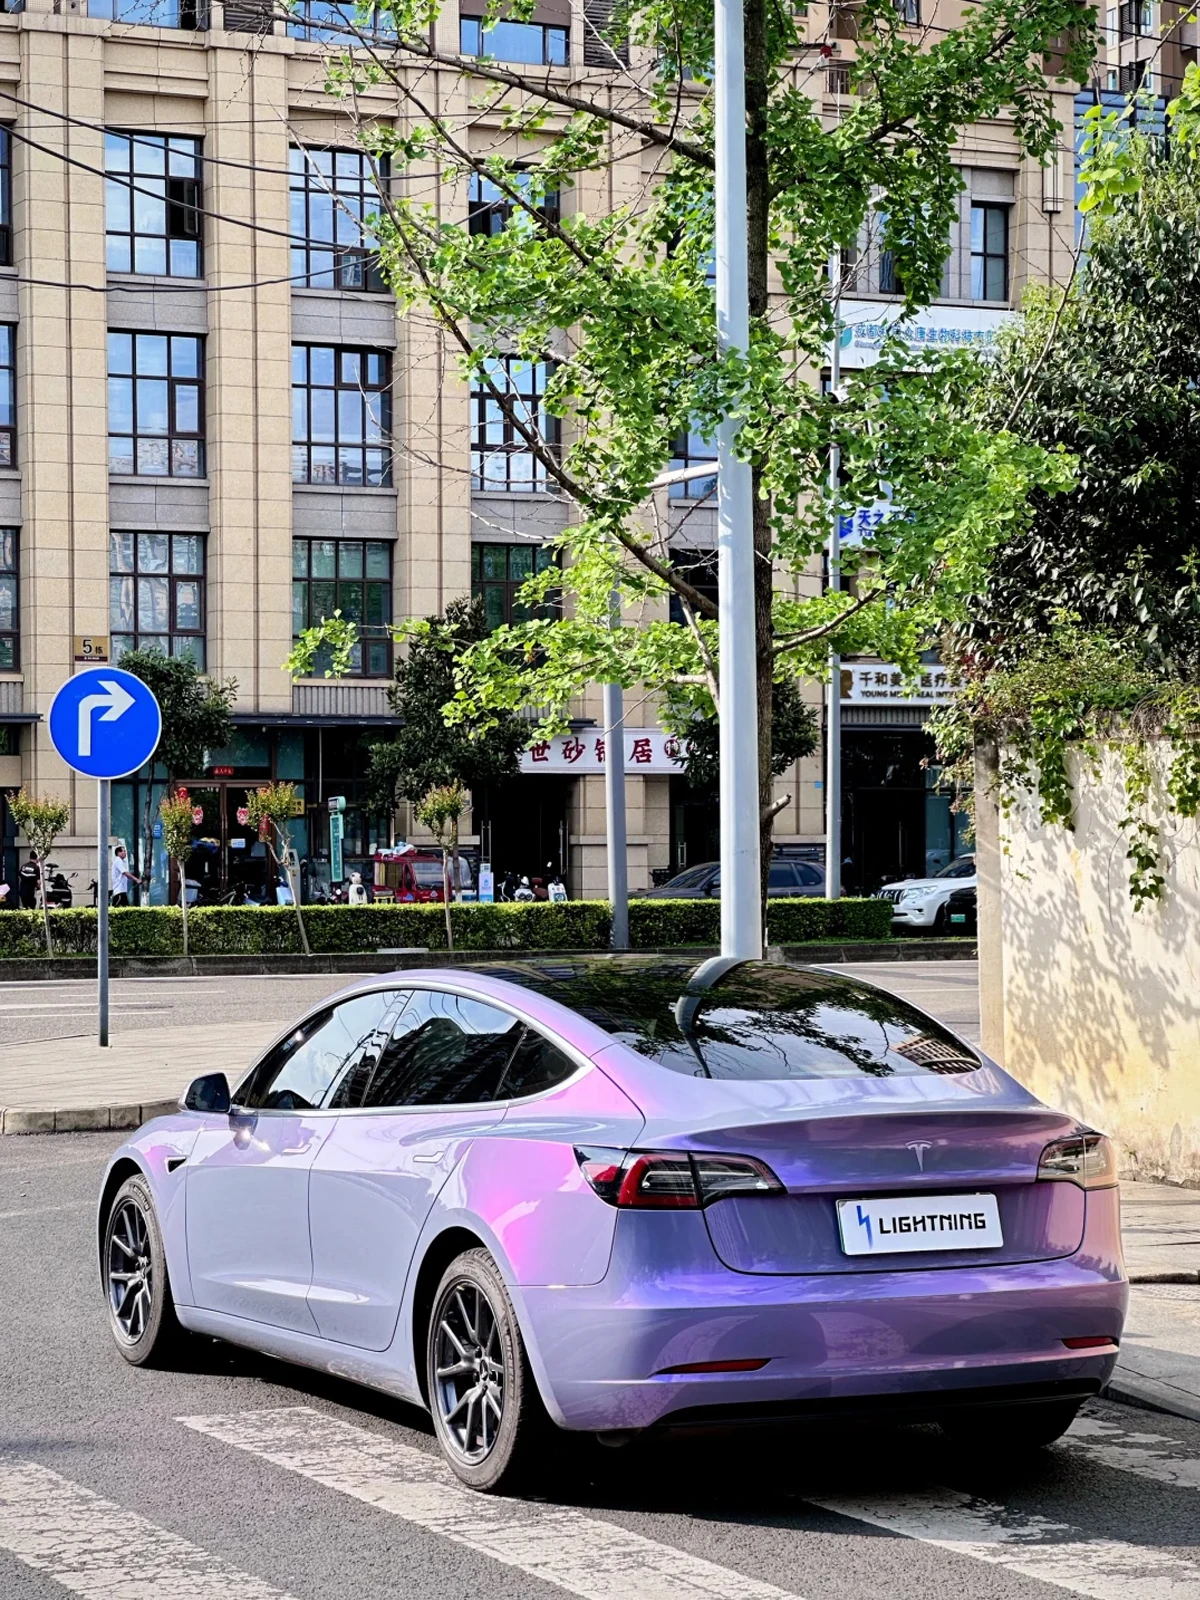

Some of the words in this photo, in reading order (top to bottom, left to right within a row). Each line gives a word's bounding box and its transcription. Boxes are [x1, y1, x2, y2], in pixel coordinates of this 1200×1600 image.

[859, 671, 971, 688] 千和美医疗
[861, 690, 888, 699] YOUNG
[879, 1213, 986, 1235] LIGHTNING
